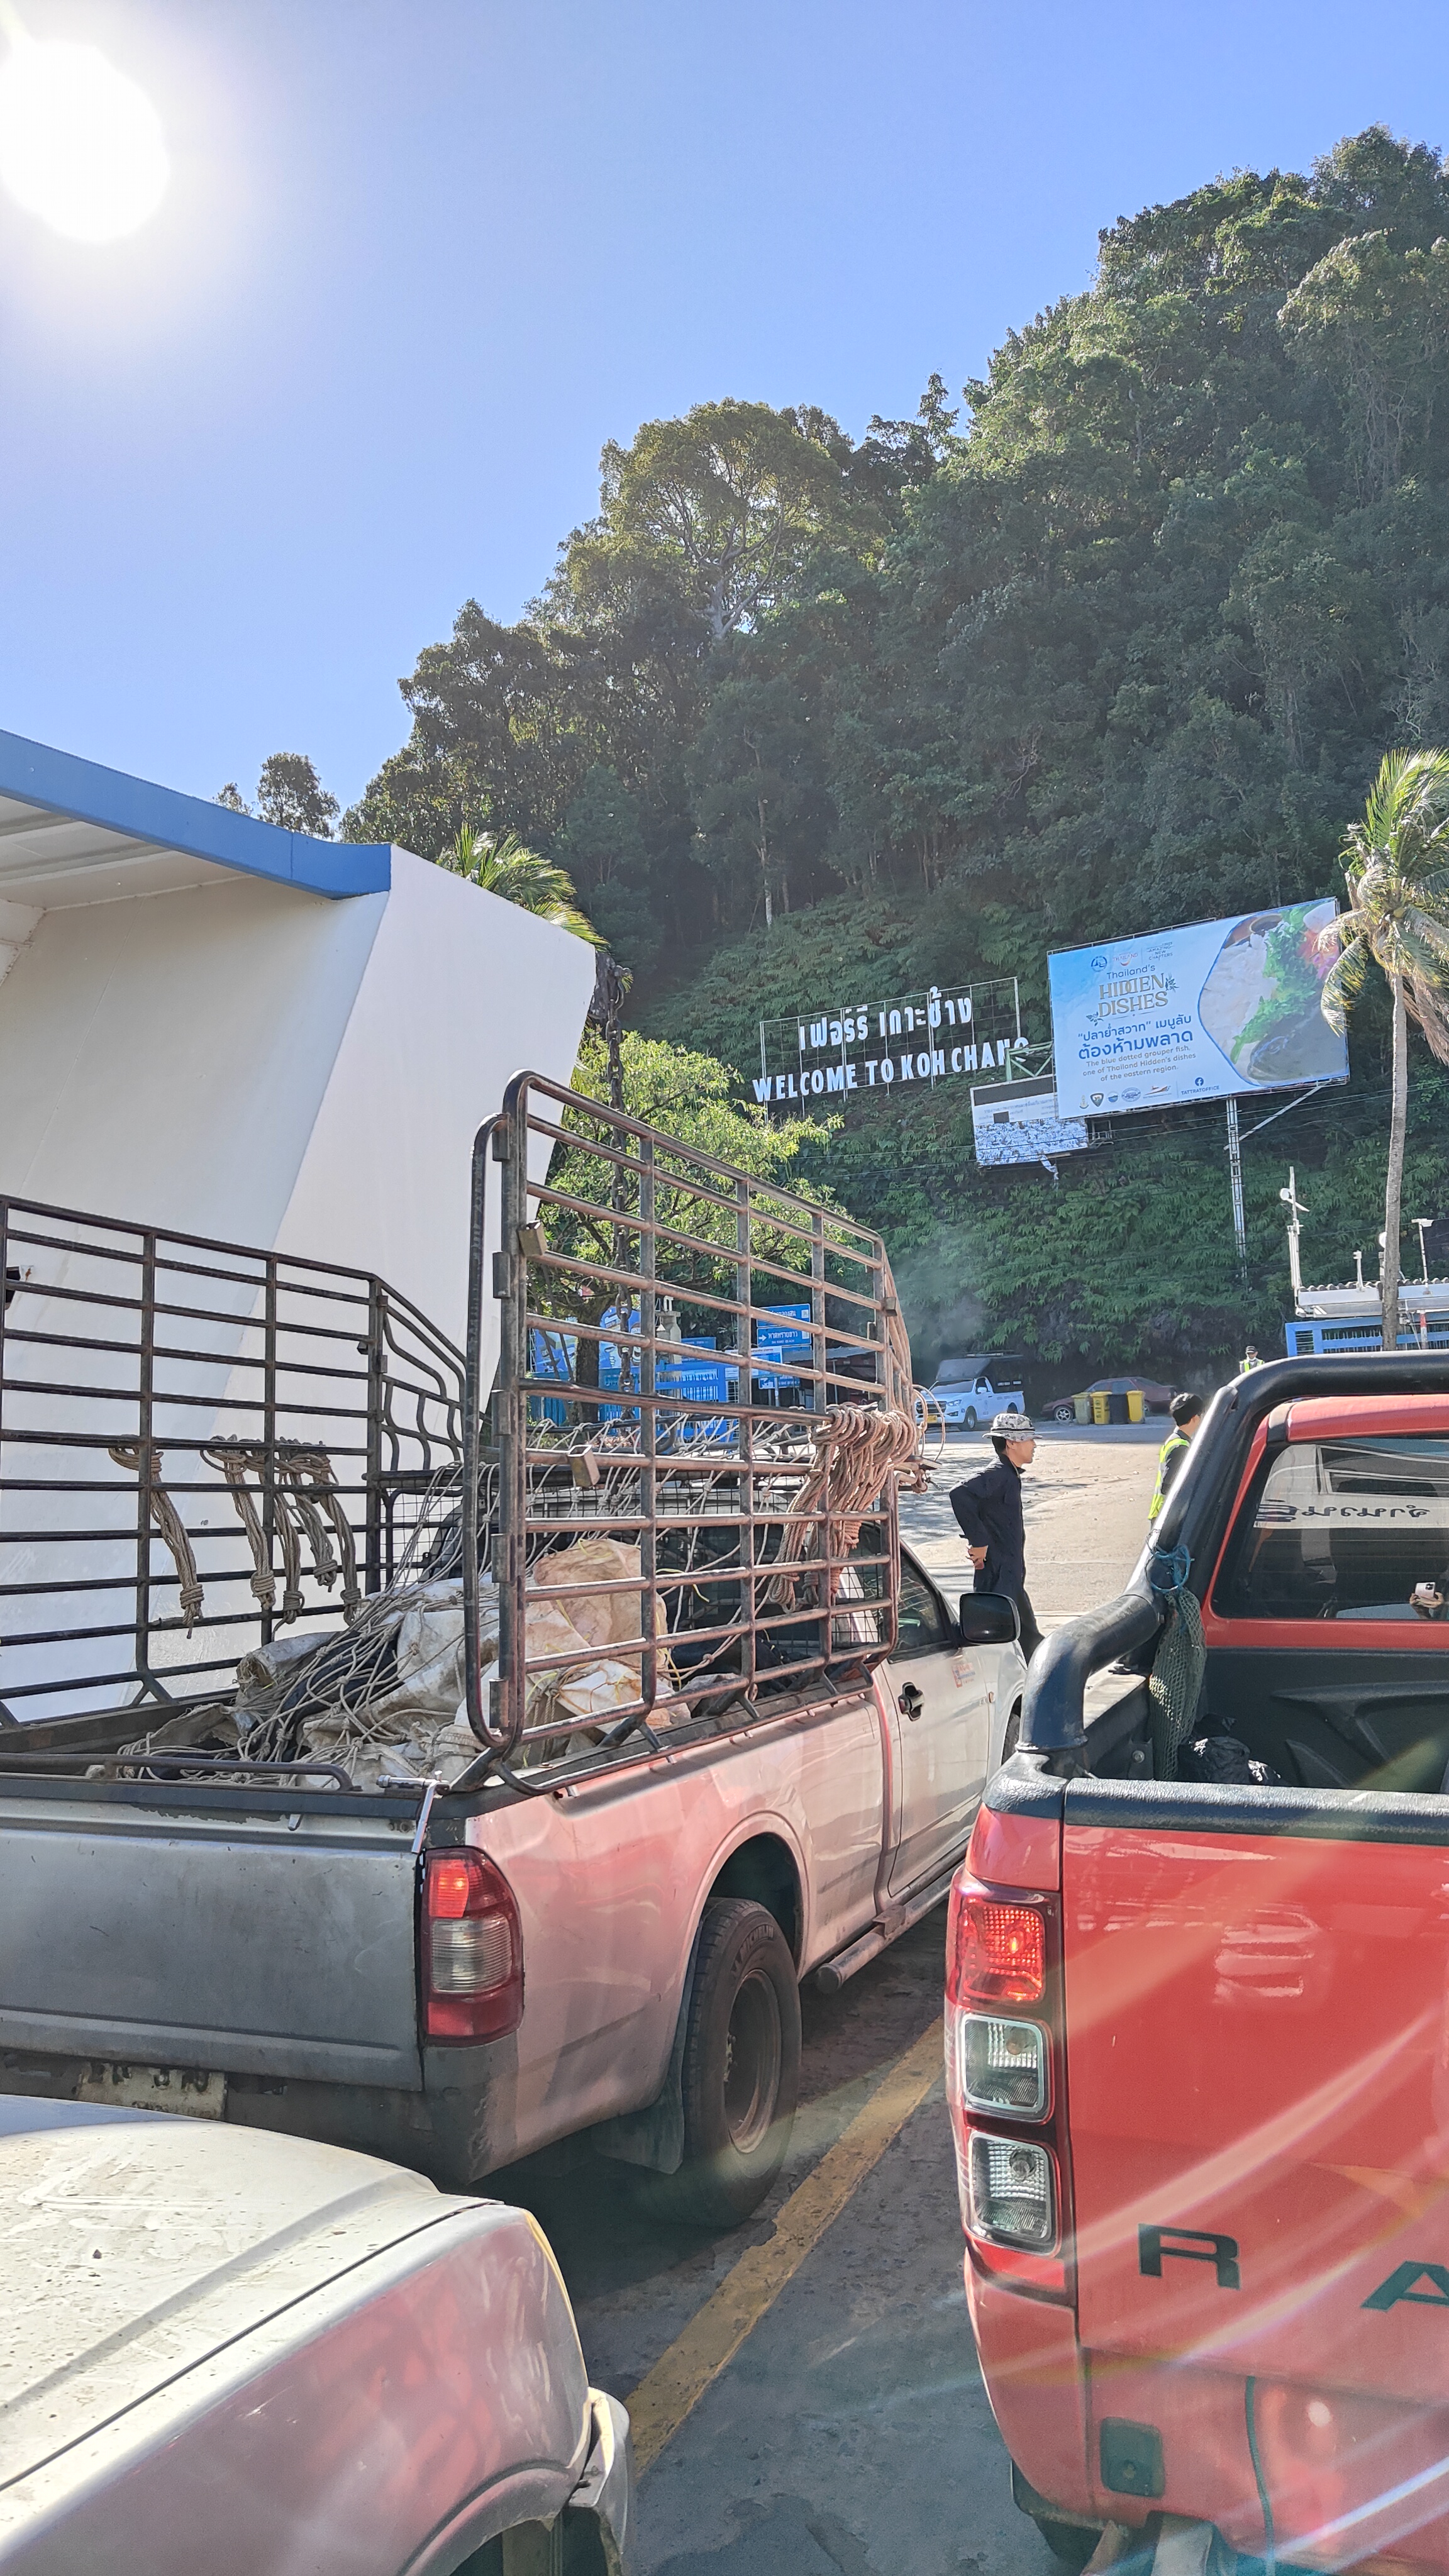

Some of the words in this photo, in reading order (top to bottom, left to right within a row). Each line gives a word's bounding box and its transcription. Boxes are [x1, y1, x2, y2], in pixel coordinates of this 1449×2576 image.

[1106, 963, 1156, 980] Thailand's
[1099, 972, 1165, 1000] HIDDEN
[1097, 991, 1169, 1018] DISHES
[1155, 1014, 1192, 1030] เมนูลับ
[1078, 1030, 1194, 1060] ต้องห้ามพลาด
[1101, 1057, 1117, 1065] blue
[1118, 1052, 1143, 1062] dotted
[1144, 1048, 1174, 1059] grouper
[1107, 1062, 1138, 1073] Thailand
[1140, 1057, 1172, 1067] Hidden's
[1173, 1053, 1197, 1062] dishes
[752, 1063, 858, 1102] WELCOME
[865, 1058, 894, 1086] TO
[901, 1049, 945, 1080] KOH
[1124, 1069, 1152, 1079] eastern
[1180, 1085, 1220, 1096] TATTRATOFFICE
